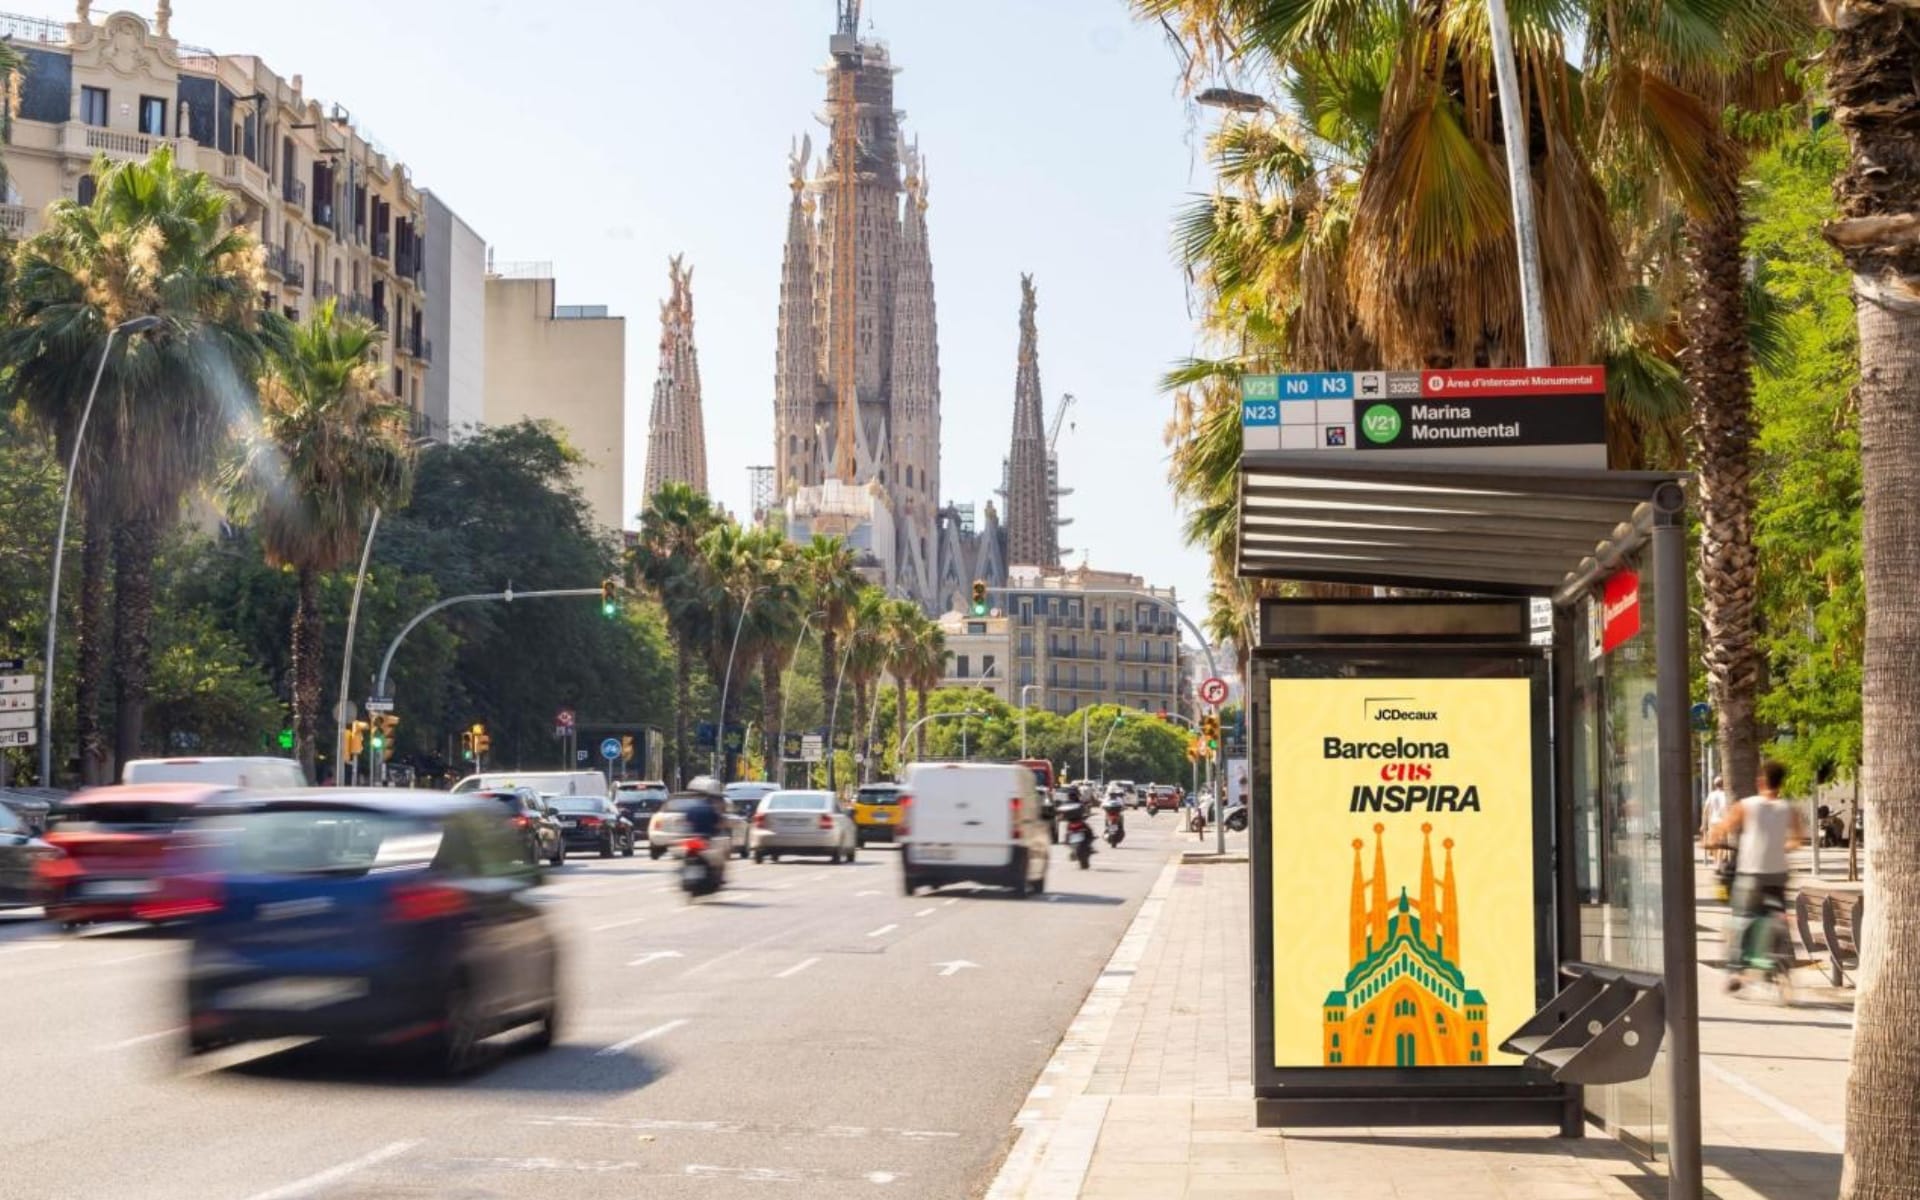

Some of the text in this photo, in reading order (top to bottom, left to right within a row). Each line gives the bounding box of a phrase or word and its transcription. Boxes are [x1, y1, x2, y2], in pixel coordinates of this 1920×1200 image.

[1244, 380, 1276, 396] V21
[1286, 379, 1309, 394] N0
[1322, 377, 1347, 393] N3
[1390, 382, 1419, 393] 3262
[1531, 375, 1593, 386] Monumental
[1245, 405, 1276, 420] N23
[1411, 404, 1472, 420] Marina
[1365, 415, 1397, 431] V21
[1411, 421, 1521, 440] Monumental
[1374, 709, 1437, 721] JCDecaux
[1323, 737, 1449, 759] Barcelona
[1380, 763, 1432, 781] ens
[1350, 786, 1481, 812] INSPIRA
